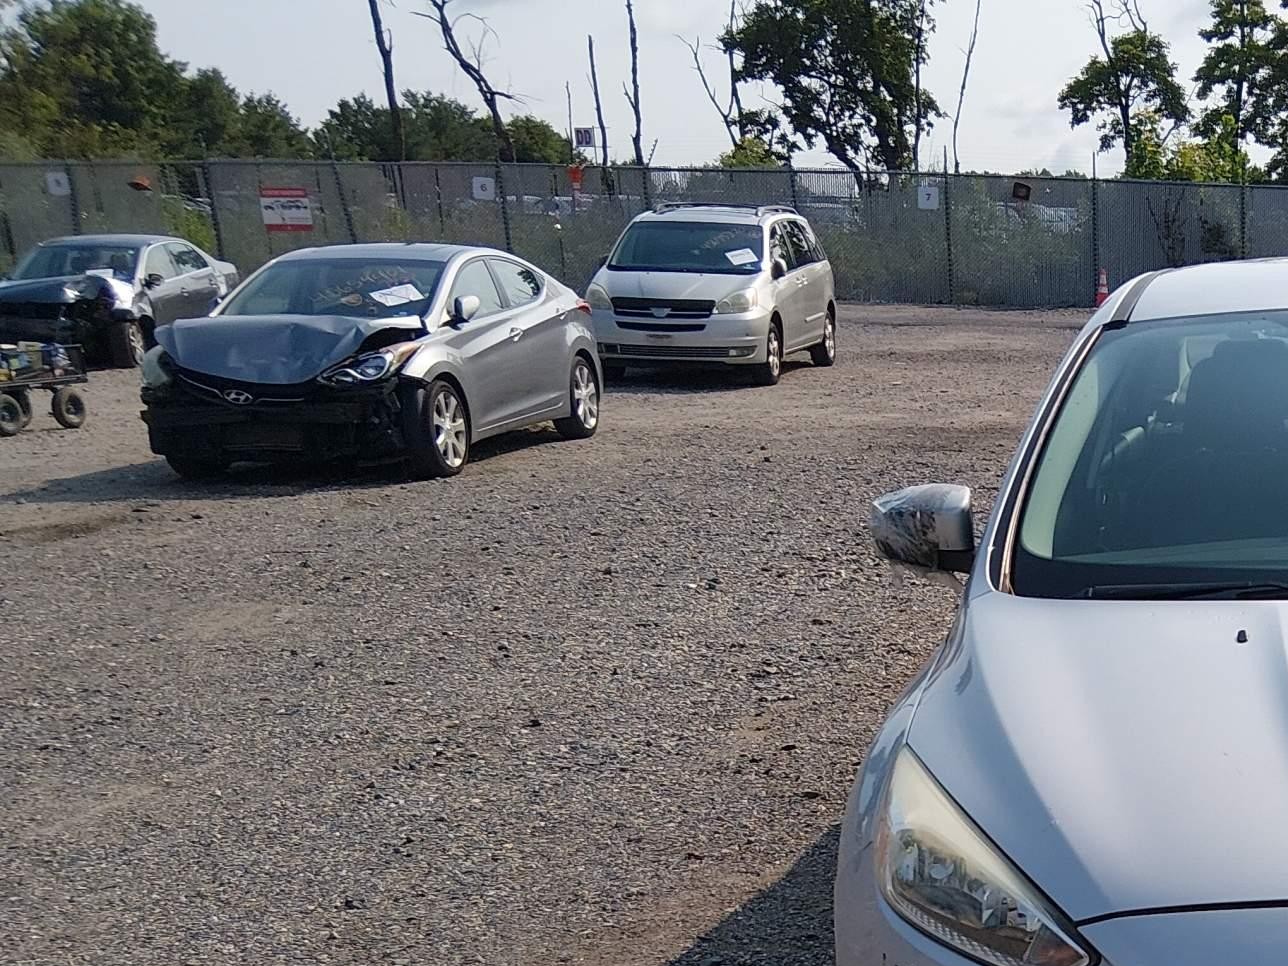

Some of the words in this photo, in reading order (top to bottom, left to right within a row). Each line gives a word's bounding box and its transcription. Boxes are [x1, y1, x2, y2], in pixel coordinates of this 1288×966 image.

[576, 129, 591, 145] DD
[480, 183, 488, 192] 6
[925, 193, 932, 201] 7
